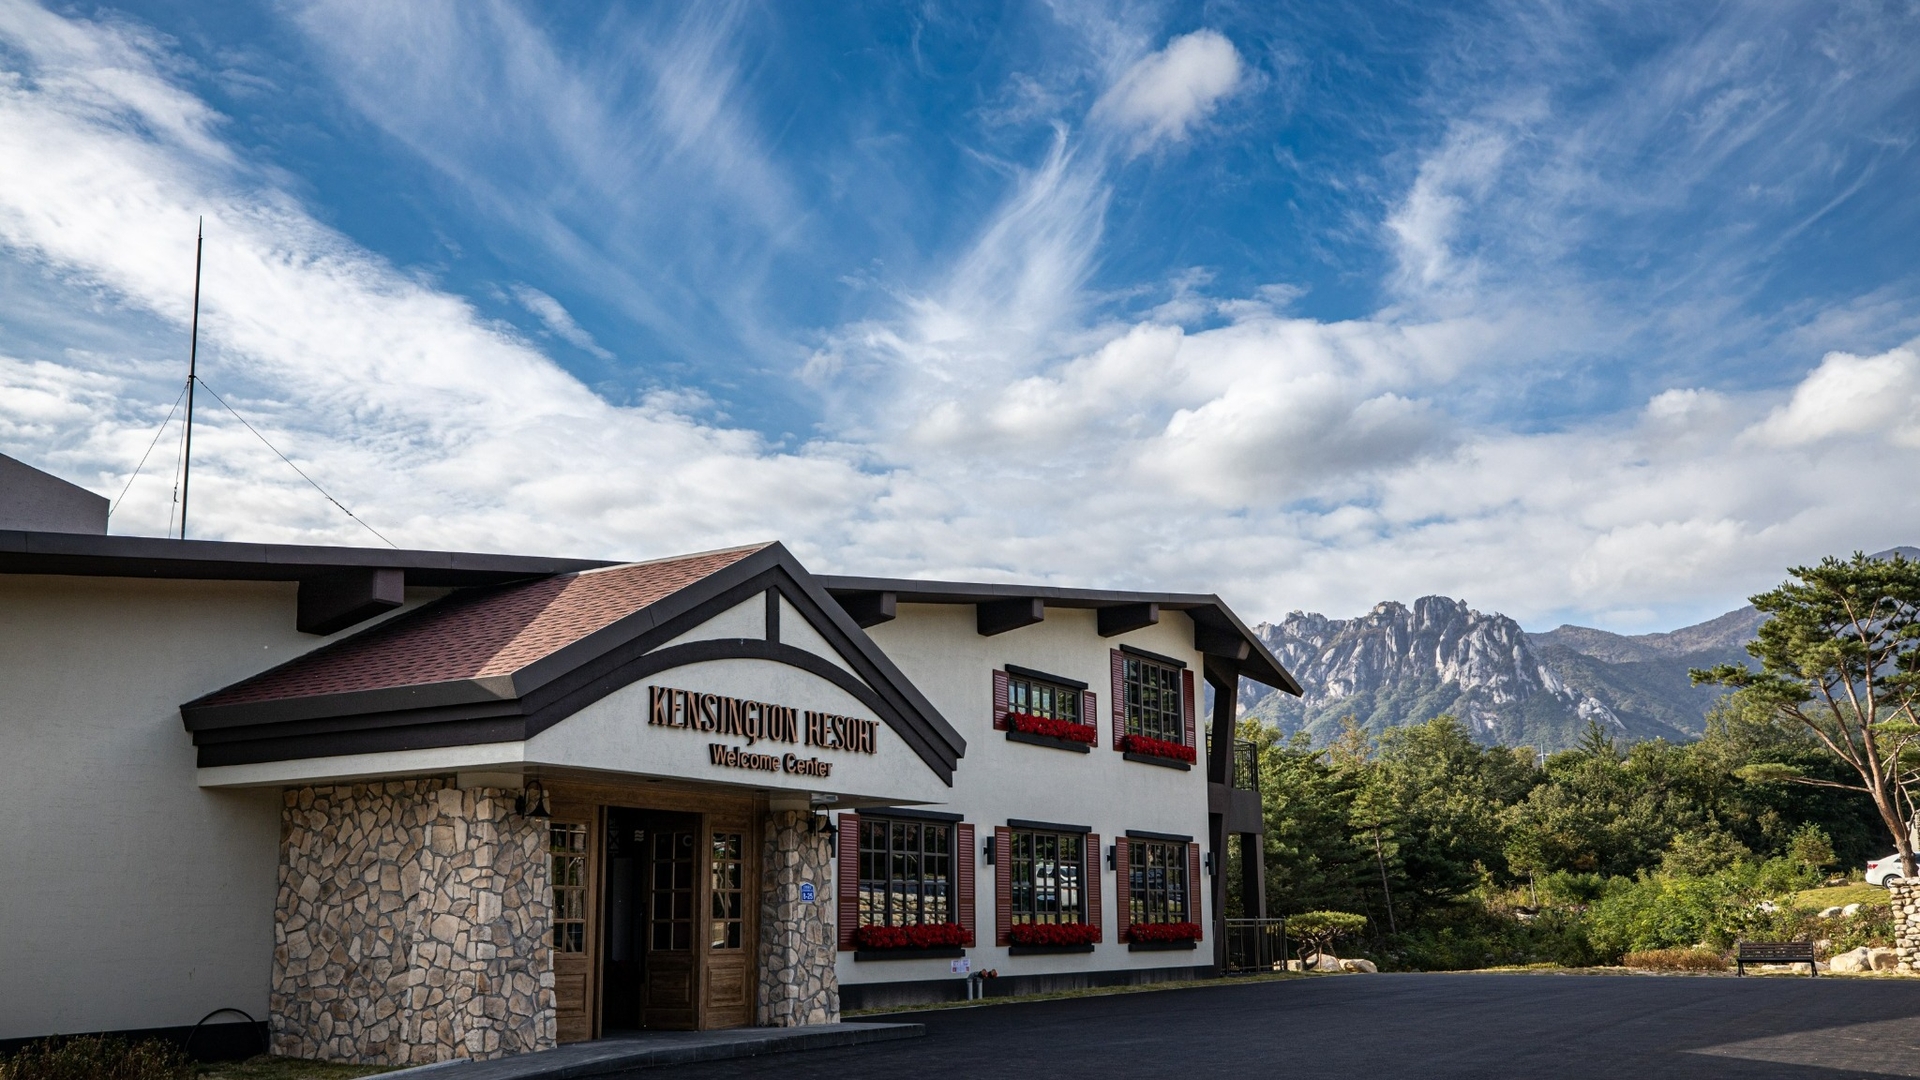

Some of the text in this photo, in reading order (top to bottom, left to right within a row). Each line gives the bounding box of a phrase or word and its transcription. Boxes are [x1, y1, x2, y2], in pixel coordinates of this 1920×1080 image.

[648, 685, 879, 754] KENSINGTON RESORT
[709, 743, 833, 777] Welcome Center
